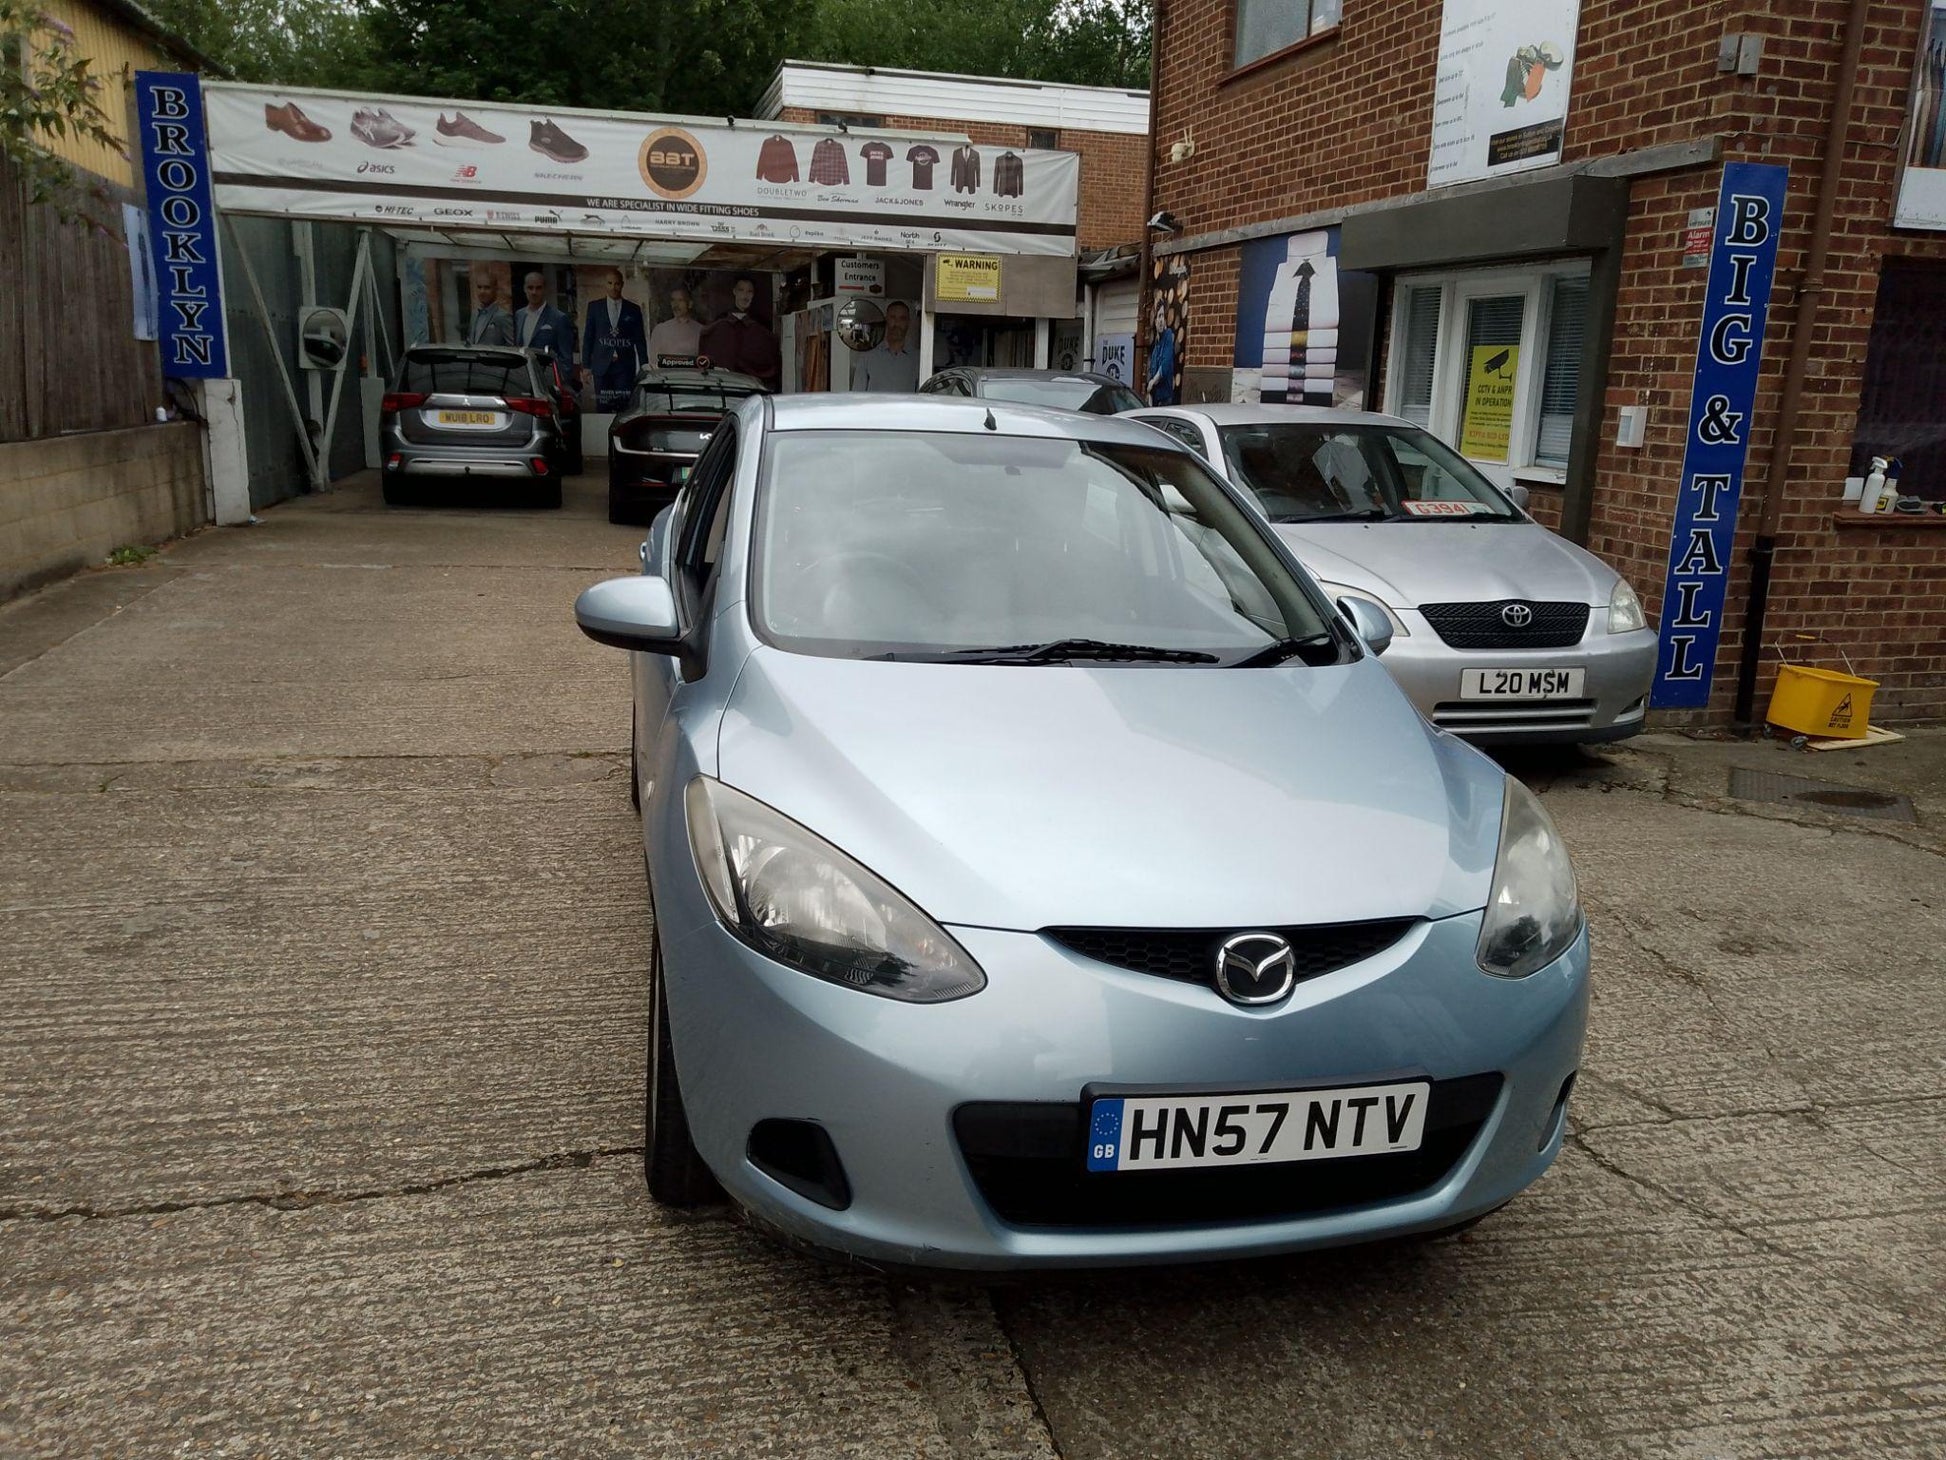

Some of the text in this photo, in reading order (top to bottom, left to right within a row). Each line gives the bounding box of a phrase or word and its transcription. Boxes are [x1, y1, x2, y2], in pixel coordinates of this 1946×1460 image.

[650, 150, 695, 166] BBT
[369, 164, 395, 174] asics
[757, 187, 807, 197] DOUBLETWO
[586, 198, 759, 217] WE ARE SPECIALIST IN WIDE FITTING SHOES
[944, 198, 976, 211] Wrangler
[984, 203, 1024, 214] SKOPES
[434, 208, 473, 217] GEOX
[534, 215, 558, 224] PUMA
[149, 85, 214, 366] BROOKLYN
[900, 231, 920, 240] North
[1688, 230, 1710, 239] Alarm
[841, 259, 880, 270] Customers
[954, 259, 998, 271] WARNING
[844, 272, 876, 282] Entrance
[1102, 345, 1125, 365] DUKE
[661, 357, 695, 367] Approved
[1477, 383, 1491, 394] CCTV
[1497, 384, 1513, 395] ANPR
[1475, 397, 1512, 408] IN OPERATION
[1664, 194, 1770, 682] BIG & TALL
[1480, 672, 1570, 693] L20 MSM
[1093, 1093, 1416, 1161] GB HN57 NTV
